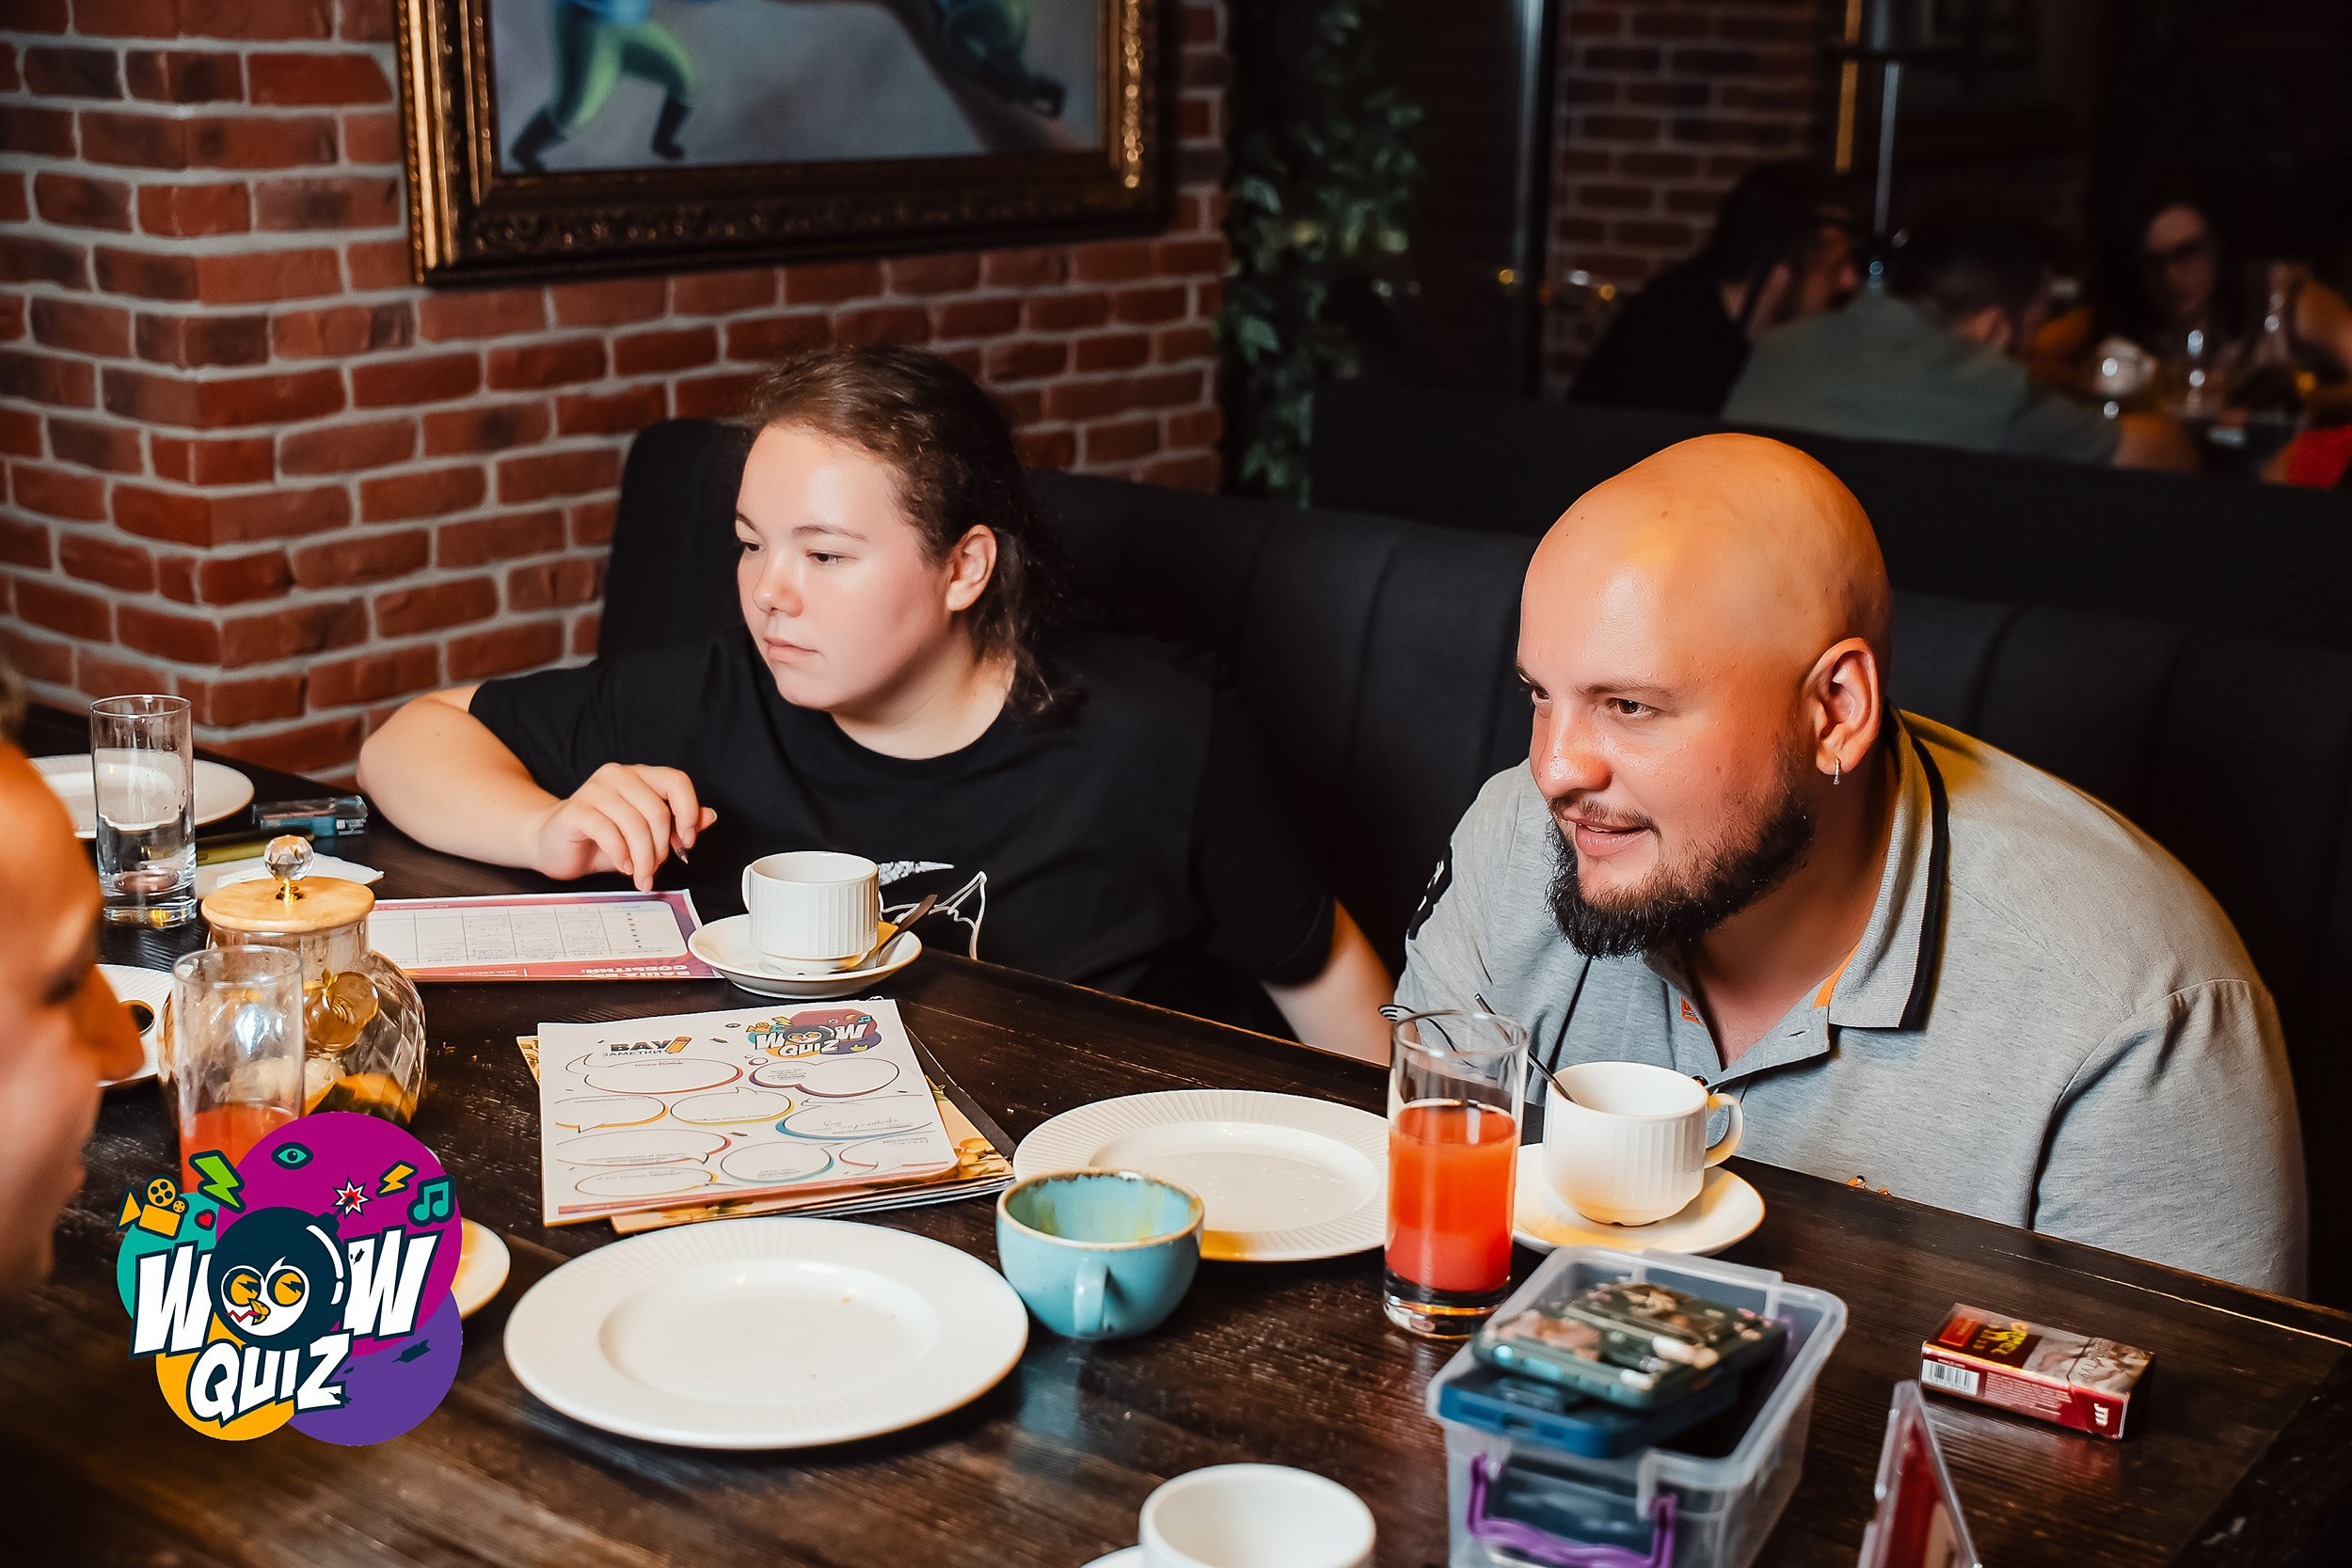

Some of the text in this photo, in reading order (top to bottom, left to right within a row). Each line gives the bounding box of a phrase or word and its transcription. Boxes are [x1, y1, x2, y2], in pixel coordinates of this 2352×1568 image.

[755, 1023, 868, 1050] WOW
[610, 1039, 672, 1053] ВАУ
[778, 1038, 840, 1056] QUIZ
